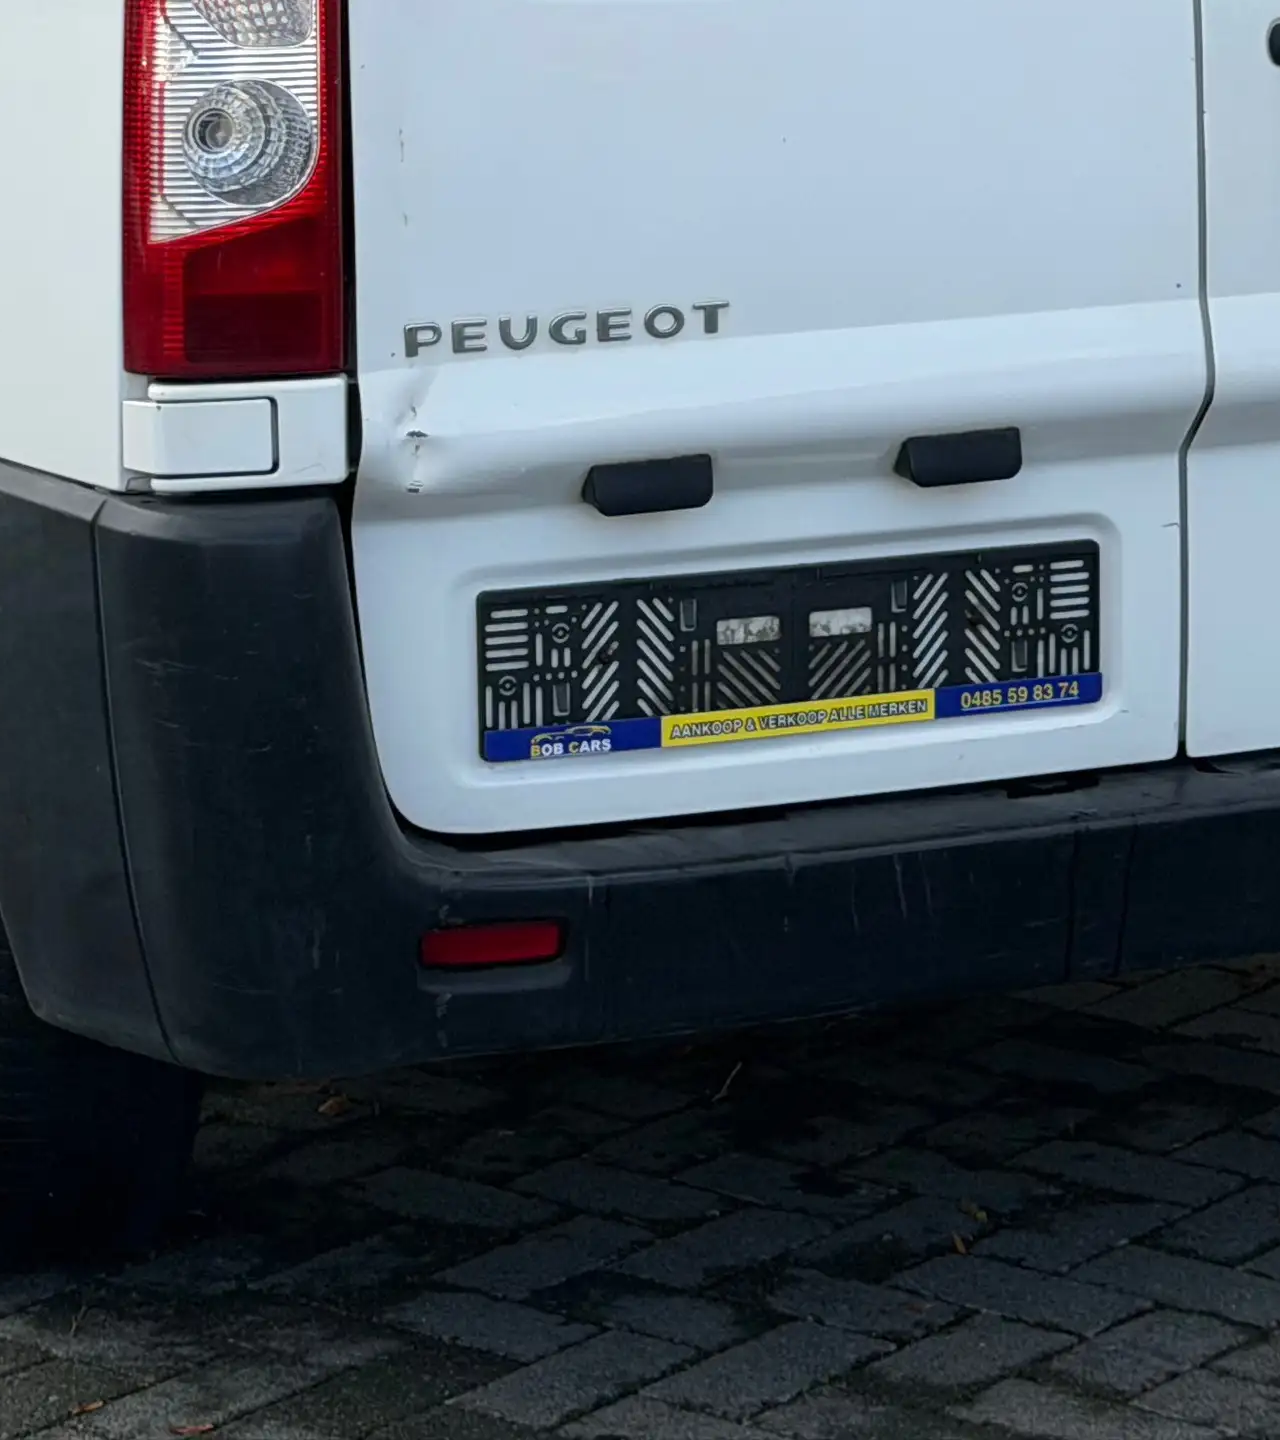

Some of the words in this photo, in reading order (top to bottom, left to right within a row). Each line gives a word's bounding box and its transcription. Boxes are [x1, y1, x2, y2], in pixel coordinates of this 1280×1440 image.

[403, 300, 730, 358] PEUGEOT
[960, 689, 1002, 708] 0485
[1007, 686, 1028, 704] 59
[1032, 683, 1053, 701] 83
[1058, 681, 1080, 697] 74
[671, 722, 742, 740] AANKOOP
[745, 718, 756, 732] &
[759, 710, 827, 729] VERKOOP
[829, 705, 865, 722] ALLE
[867, 699, 928, 718] MERKEN
[530, 742, 564, 757] BOB
[569, 738, 612, 754] CARS
